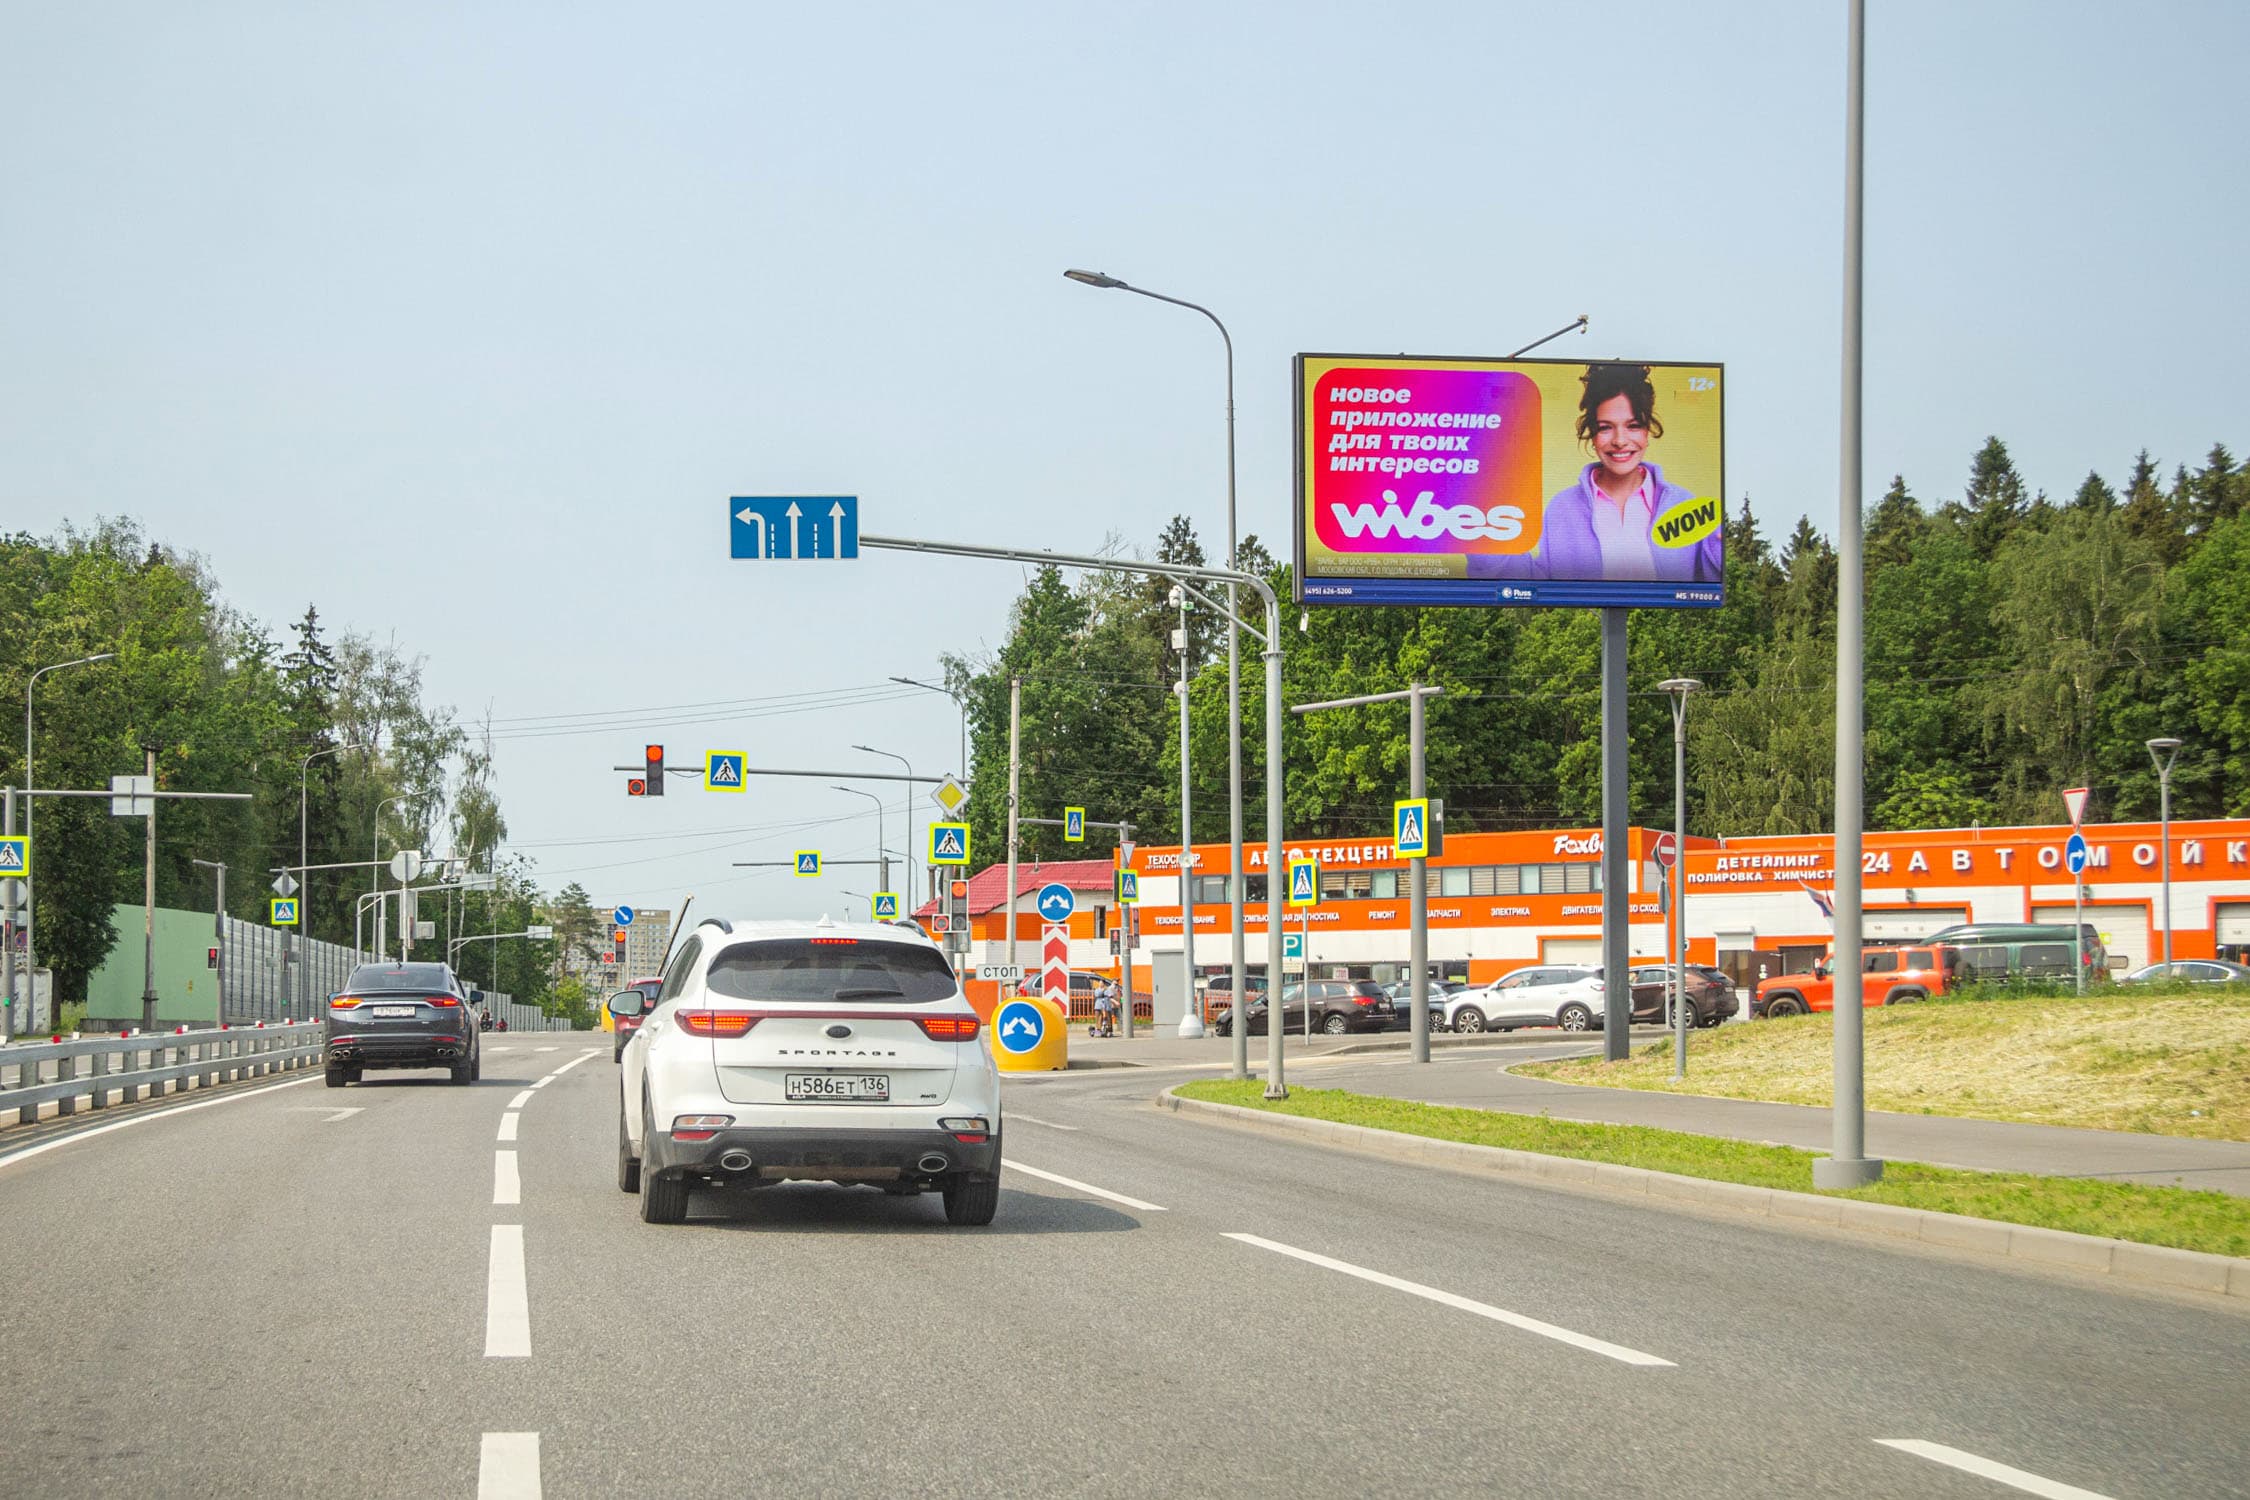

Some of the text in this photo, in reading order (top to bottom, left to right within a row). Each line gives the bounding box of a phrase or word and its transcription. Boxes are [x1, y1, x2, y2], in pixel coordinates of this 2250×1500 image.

[1688, 376, 1716, 391] 12+
[1330, 387, 1411, 404] новое
[1330, 410, 1501, 431] приложение
[1328, 434, 1471, 453] для твоих
[1330, 456, 1480, 479] интересов
[1330, 489, 1525, 541] wibes
[1657, 500, 1716, 543] WOW
[1513, 589, 1532, 597] Russ
[1716, 854, 1820, 870] ДЕТЕЙЛИНГ
[1862, 851, 1891, 873] 24
[1688, 869, 1835, 884] ПОЛИРОВКА ХИМЧИСТ
[1368, 911, 1396, 920] РЕМОНТ
[1490, 906, 1530, 916] ЭЛЕКТРИКА
[983, 966, 1018, 978] СТОП
[860, 1077, 885, 1090] 136
